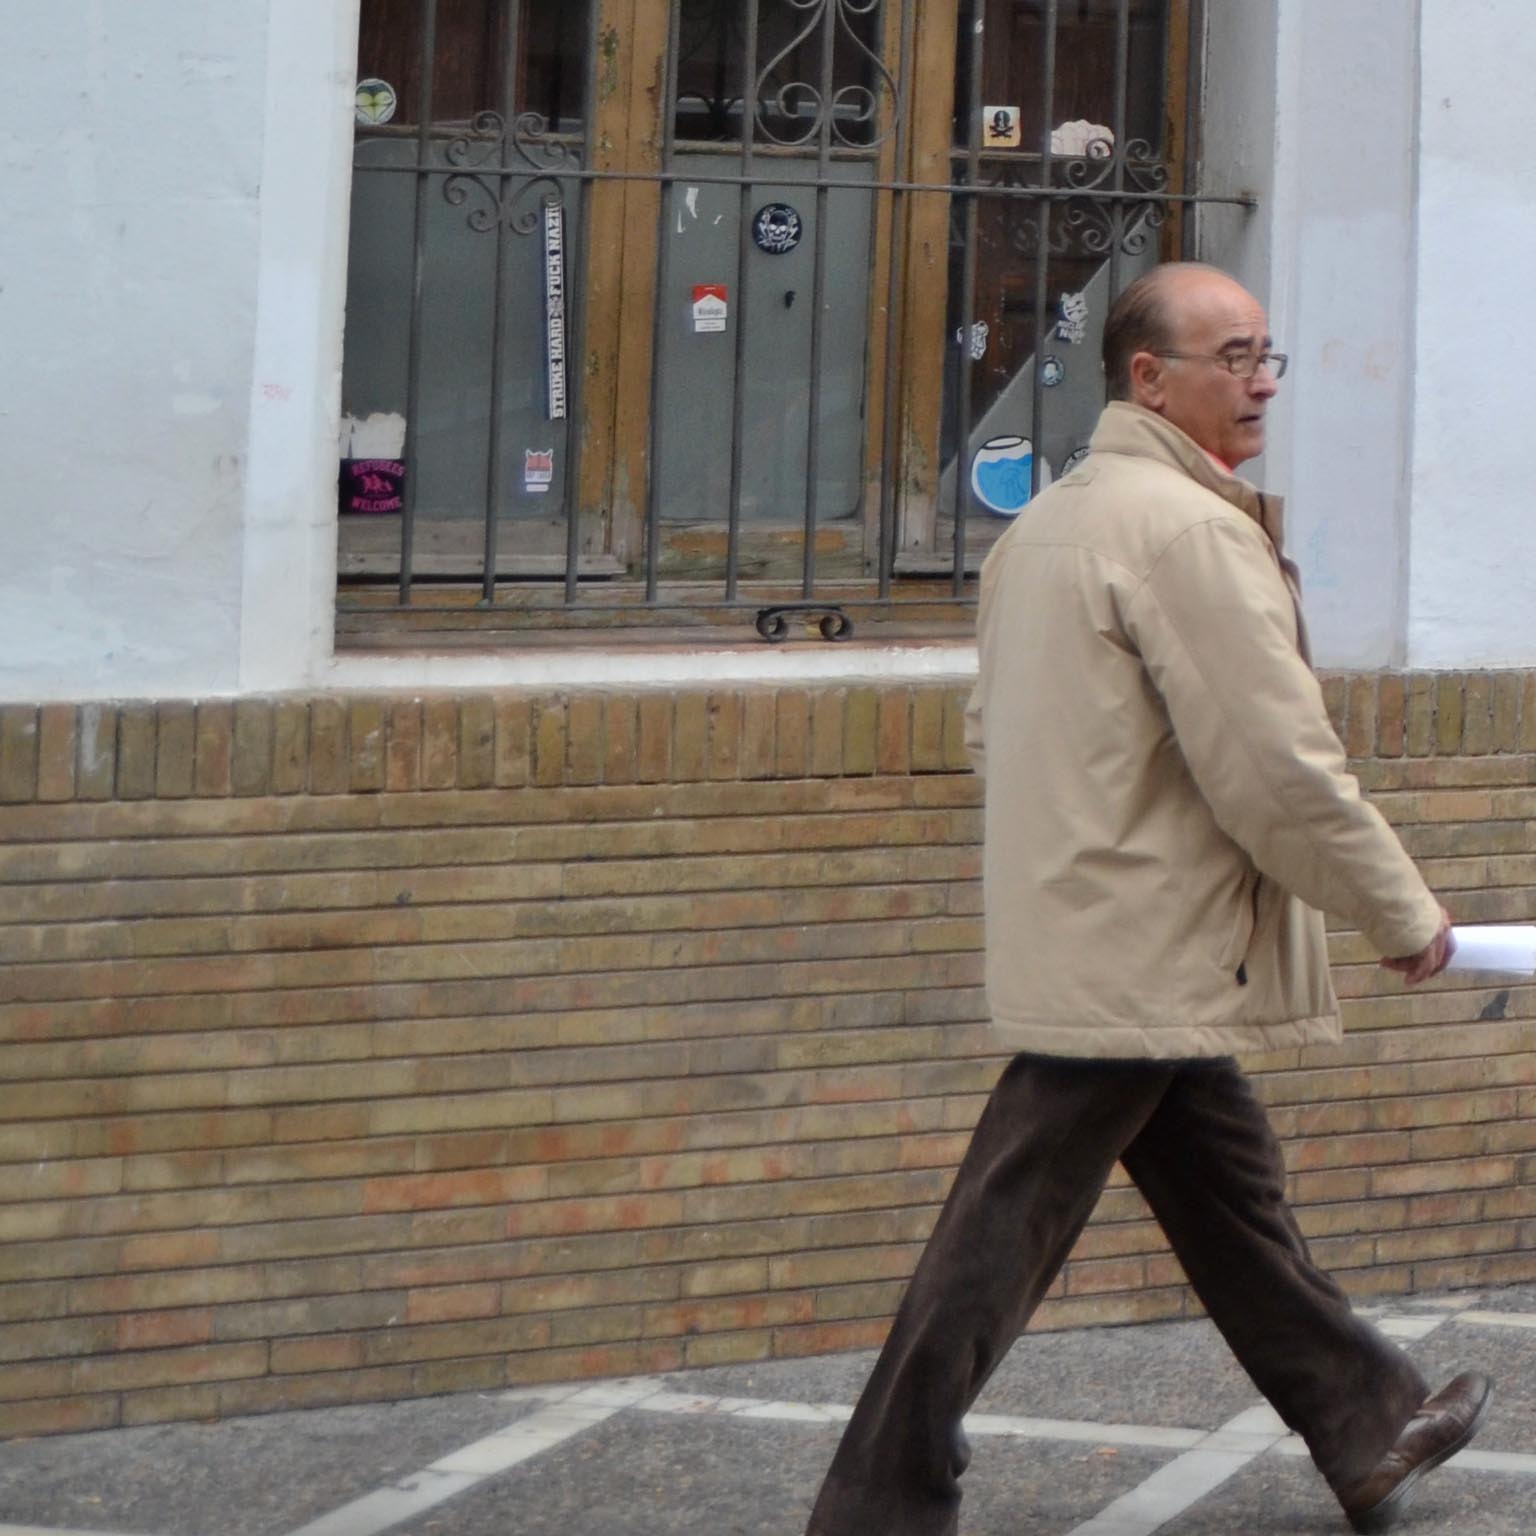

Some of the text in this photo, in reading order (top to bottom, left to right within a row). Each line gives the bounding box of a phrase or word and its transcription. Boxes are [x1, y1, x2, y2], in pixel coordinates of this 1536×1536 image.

[548, 255, 561, 295] FUCK
[549, 318, 563, 360] HARD
[550, 362, 565, 418] STRIKE
